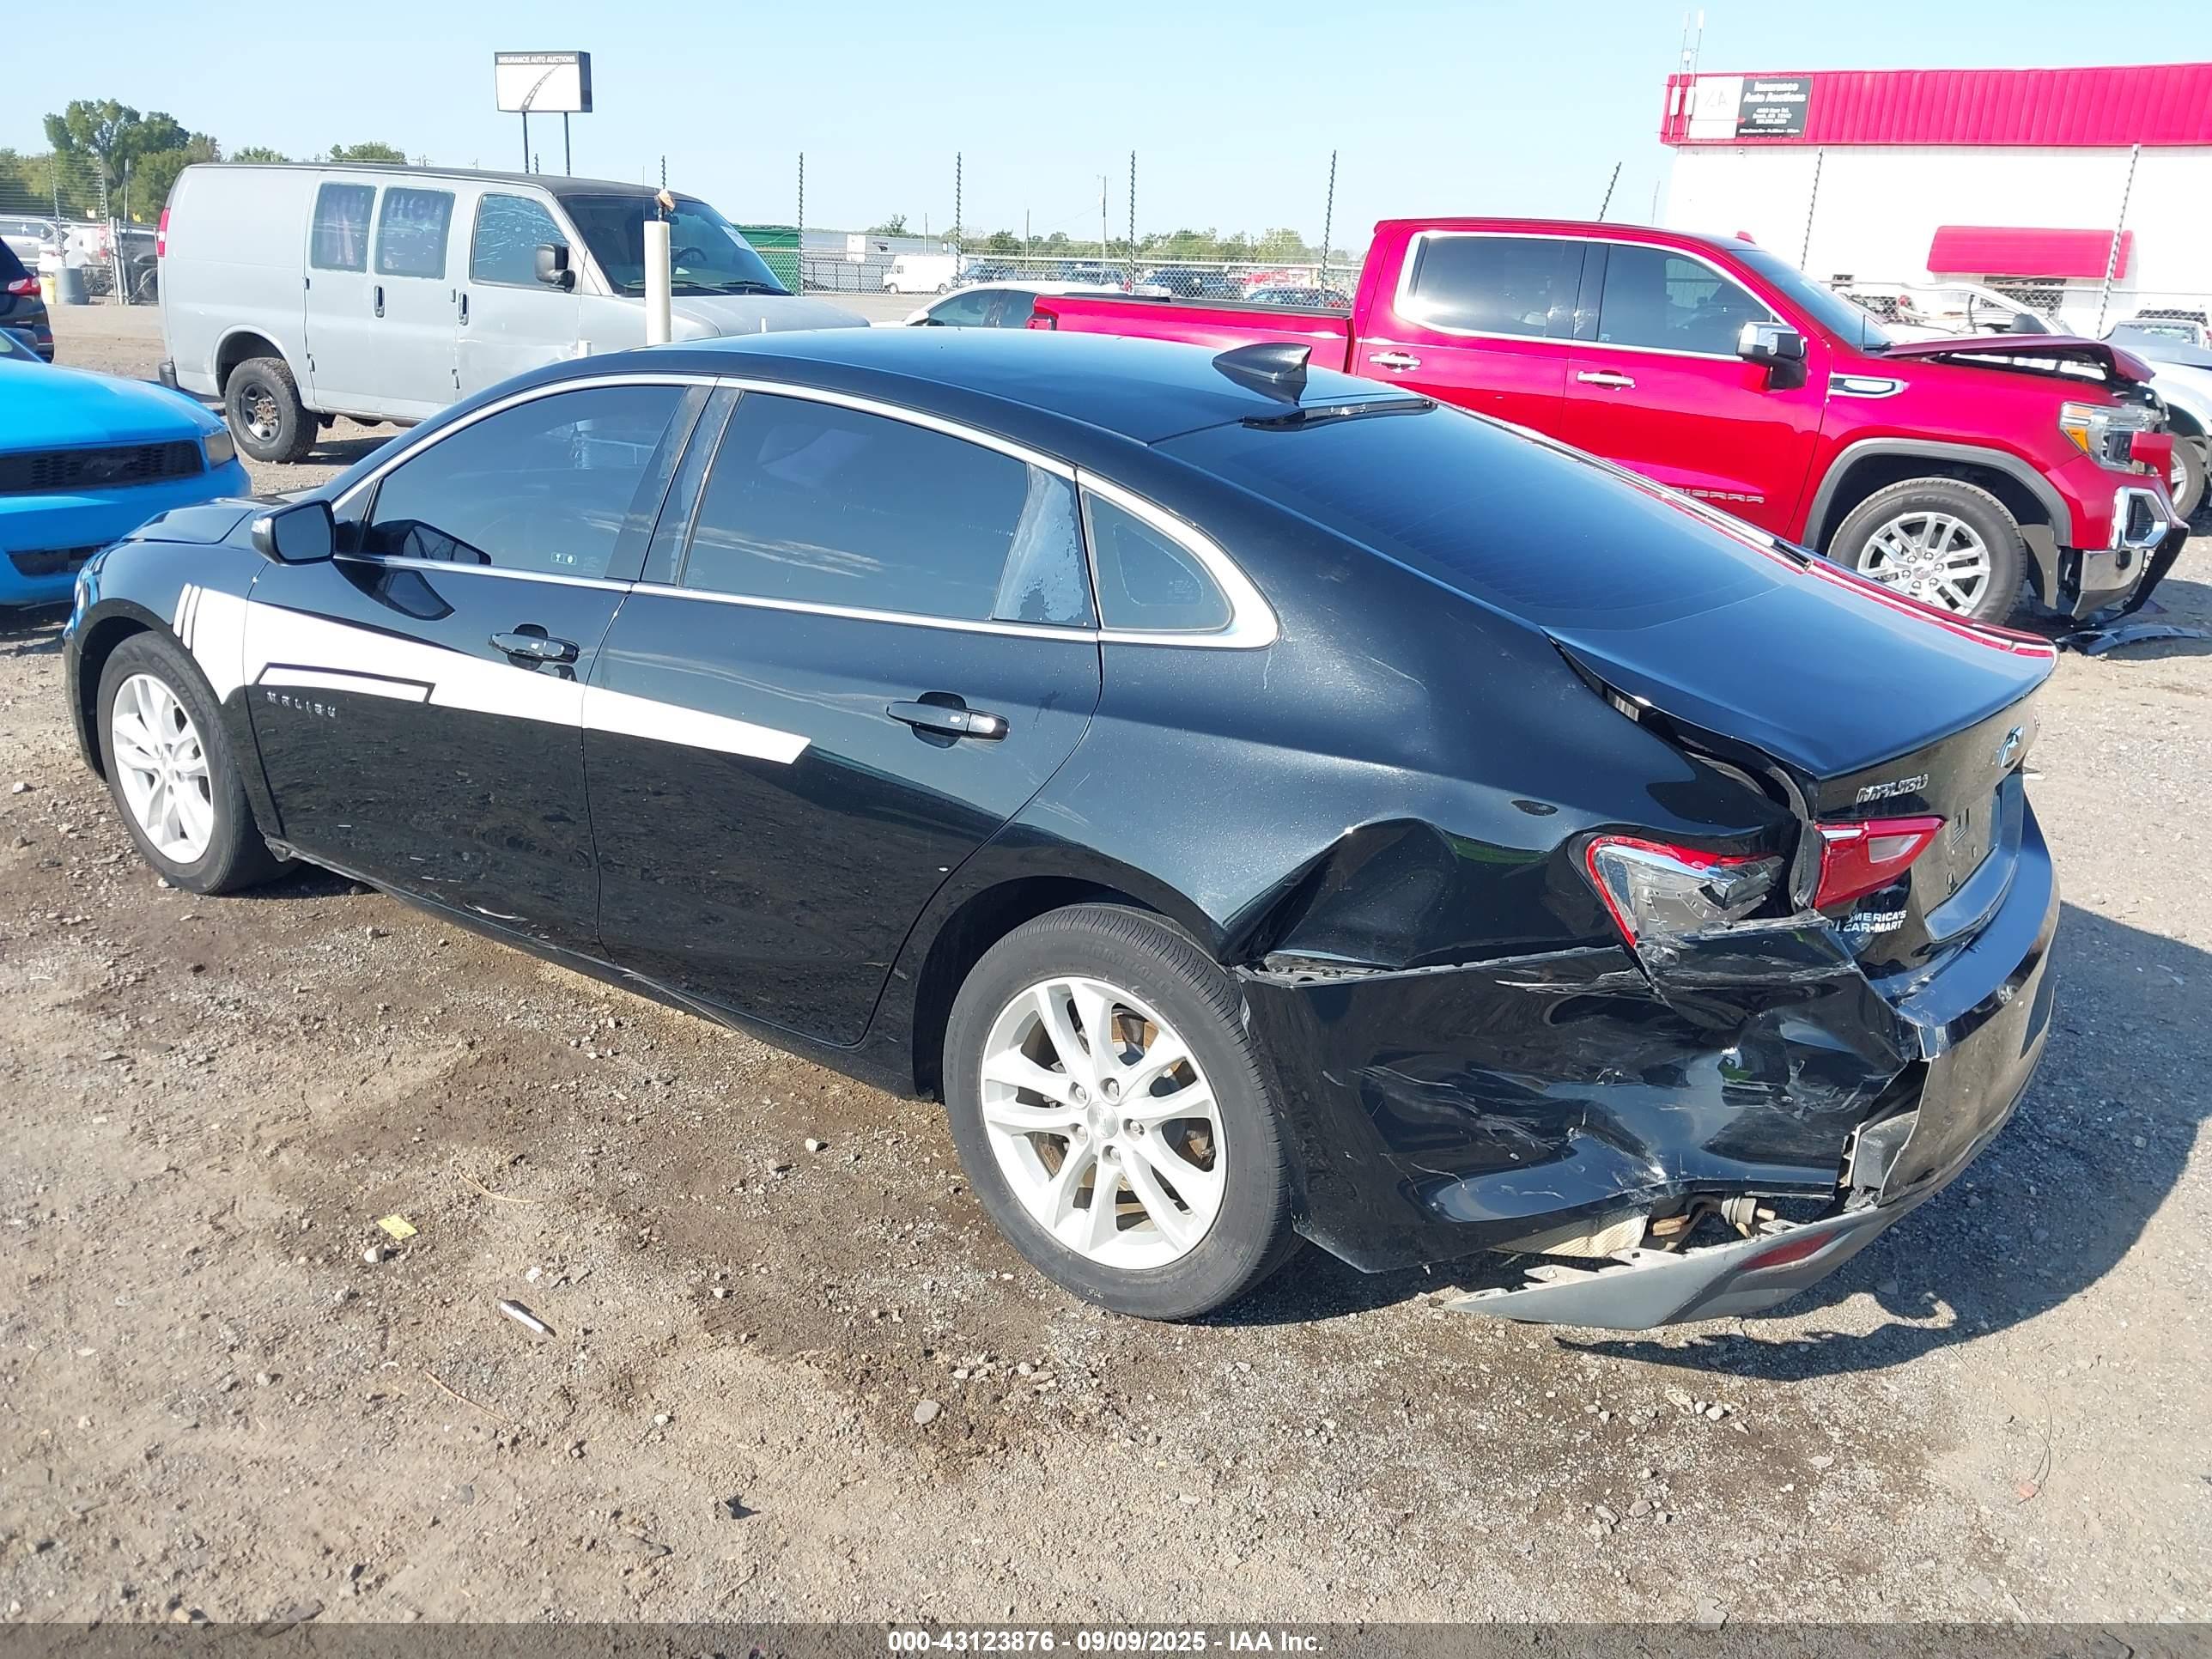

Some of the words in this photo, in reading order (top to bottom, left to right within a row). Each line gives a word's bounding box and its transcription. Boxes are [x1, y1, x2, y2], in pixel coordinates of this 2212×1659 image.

[1743, 92, 1765, 103] Auto
[1765, 92, 1807, 103] Auctions
[266, 690, 336, 719] MALIBU
[1856, 773, 1929, 804] MALIBU
